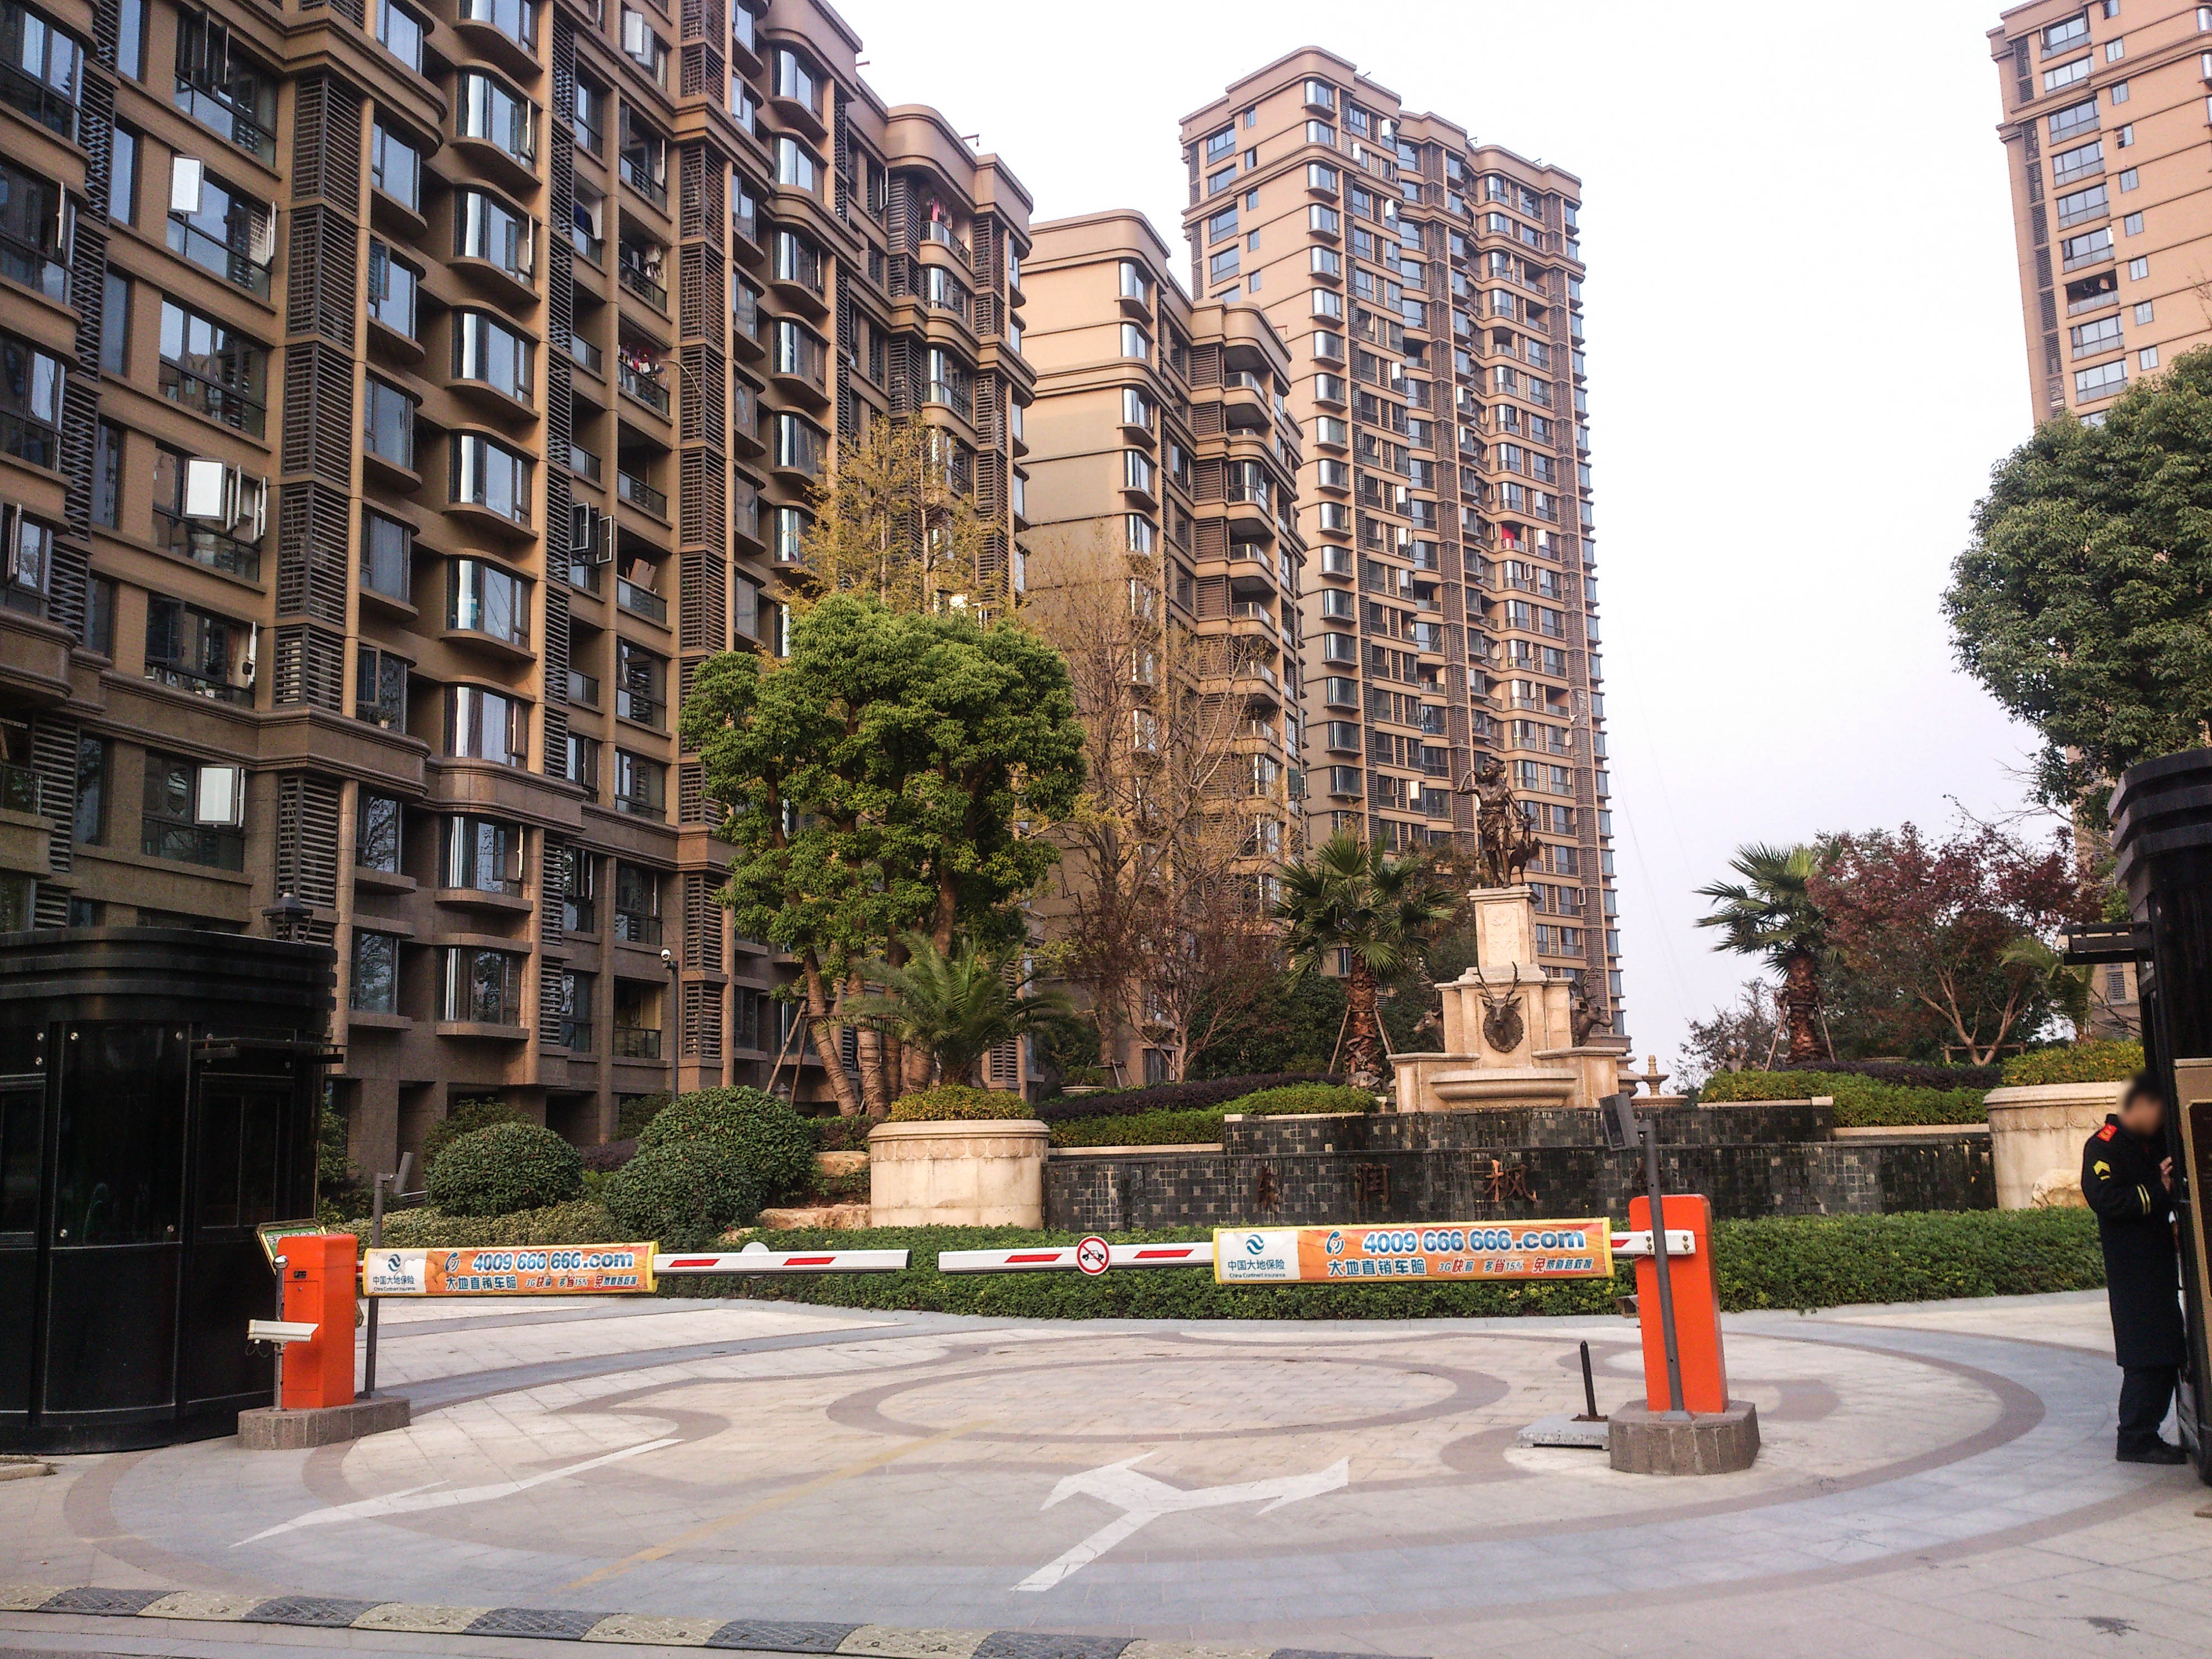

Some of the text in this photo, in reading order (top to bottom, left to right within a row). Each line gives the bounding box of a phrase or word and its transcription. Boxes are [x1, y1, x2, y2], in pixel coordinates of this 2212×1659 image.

[1364, 1229, 1584, 1253] 4009 666 666.com
[473, 1252, 633, 1270] 4009 666 666.com
[1228, 1259, 1285, 1271] 中国大地保险
[1328, 1259, 1426, 1276] 大地直销车险
[373, 1275, 414, 1285] 中国大地保险
[446, 1276, 517, 1290] 大地直销车险
